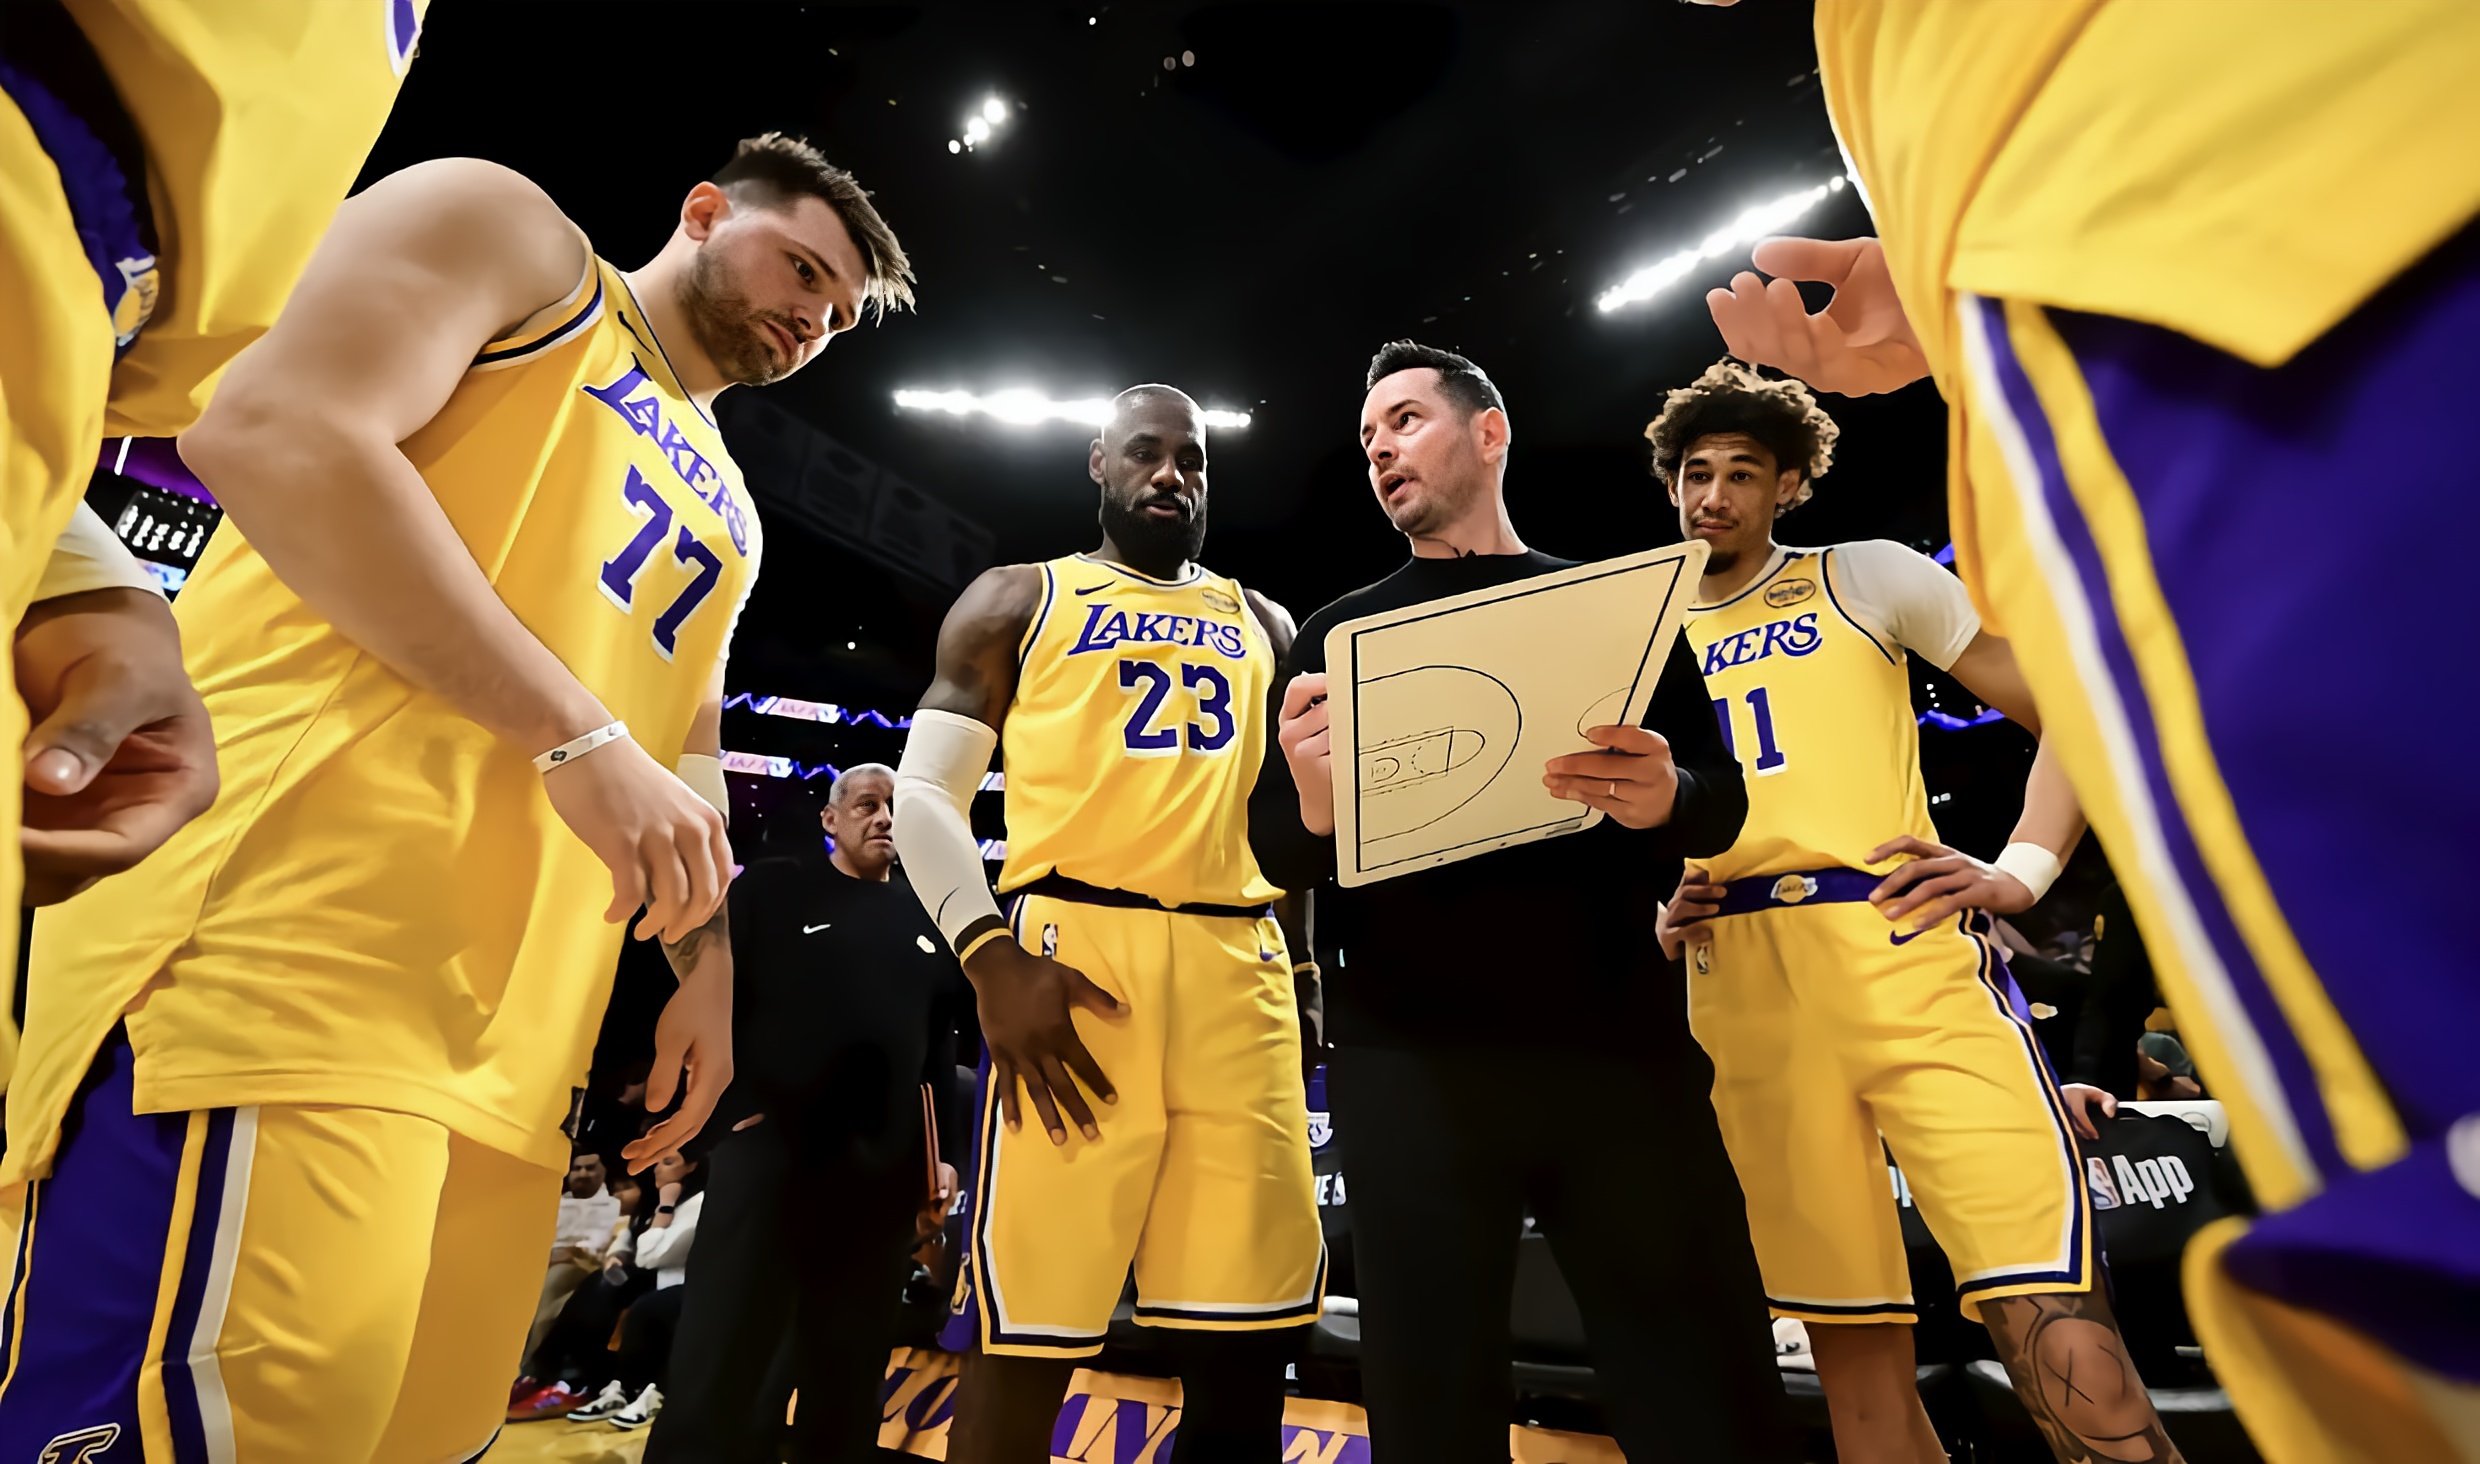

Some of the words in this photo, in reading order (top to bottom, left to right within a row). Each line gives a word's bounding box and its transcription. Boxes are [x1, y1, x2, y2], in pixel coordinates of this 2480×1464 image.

[582, 352, 748, 558] LAKERS
[600, 463, 724, 657] 77
[1067, 603, 1247, 659] LAKERS
[1118, 659, 1236, 752] 23
[2112, 1155, 2194, 1209] App
